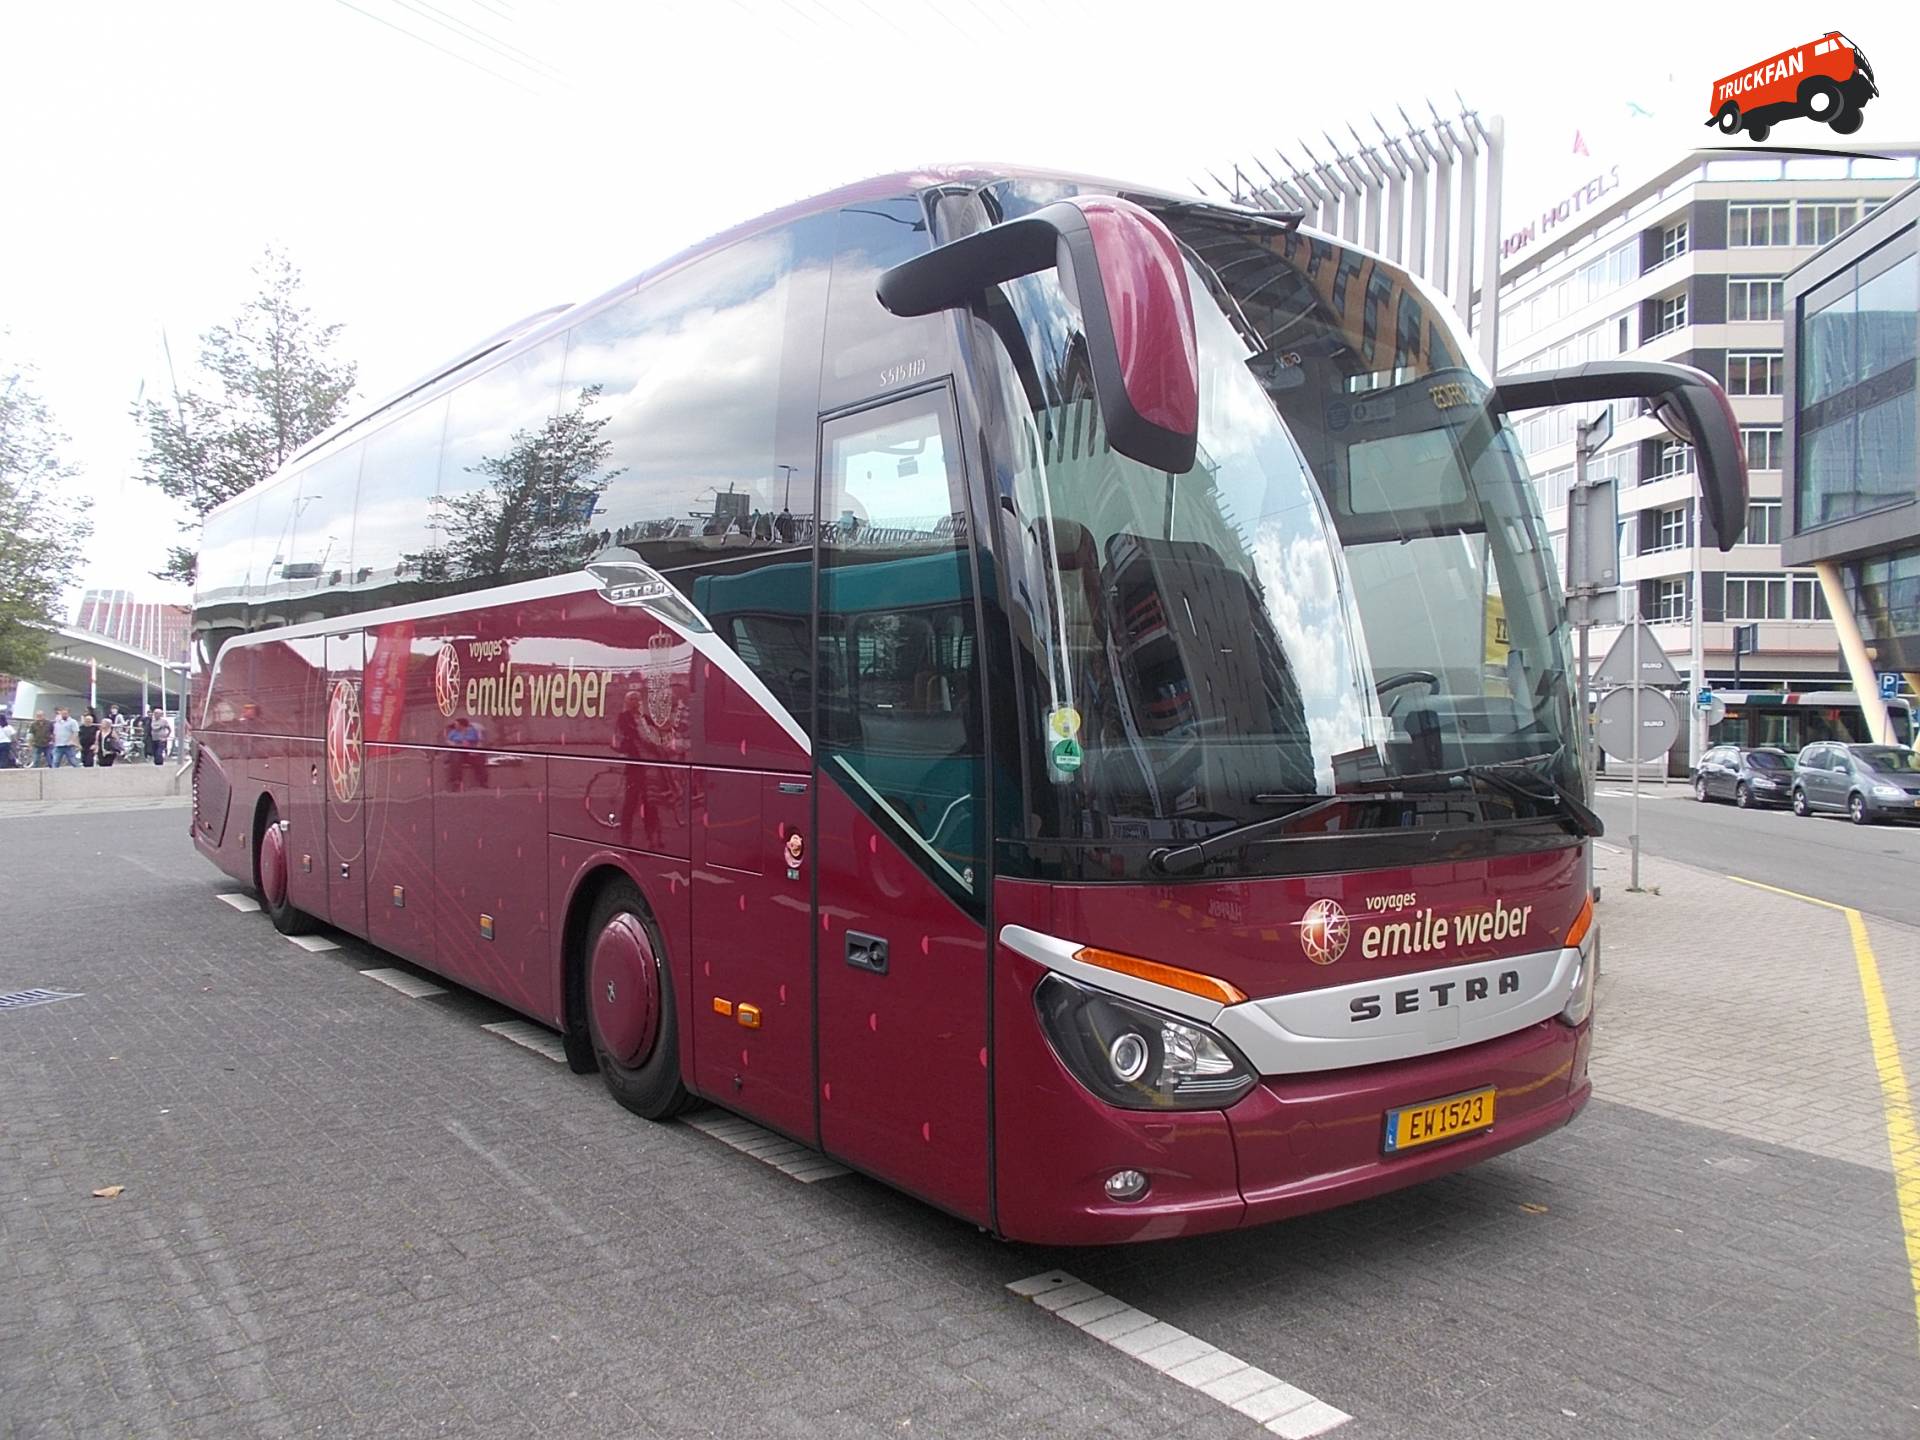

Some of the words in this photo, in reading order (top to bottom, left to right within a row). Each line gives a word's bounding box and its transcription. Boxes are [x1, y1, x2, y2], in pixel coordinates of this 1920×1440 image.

[1542, 164, 1619, 234] HOTELS
[610, 583, 665, 600] SETRA
[469, 639, 503, 662] voyages
[466, 661, 525, 717] emile
[529, 656, 613, 718] weber
[1883, 675, 1895, 690] P
[1064, 741, 1074, 756] 4
[1366, 892, 1417, 914] voyages
[1362, 908, 1449, 959] emile
[1454, 898, 1532, 946] weber
[1350, 970, 1519, 1022] SETRA
